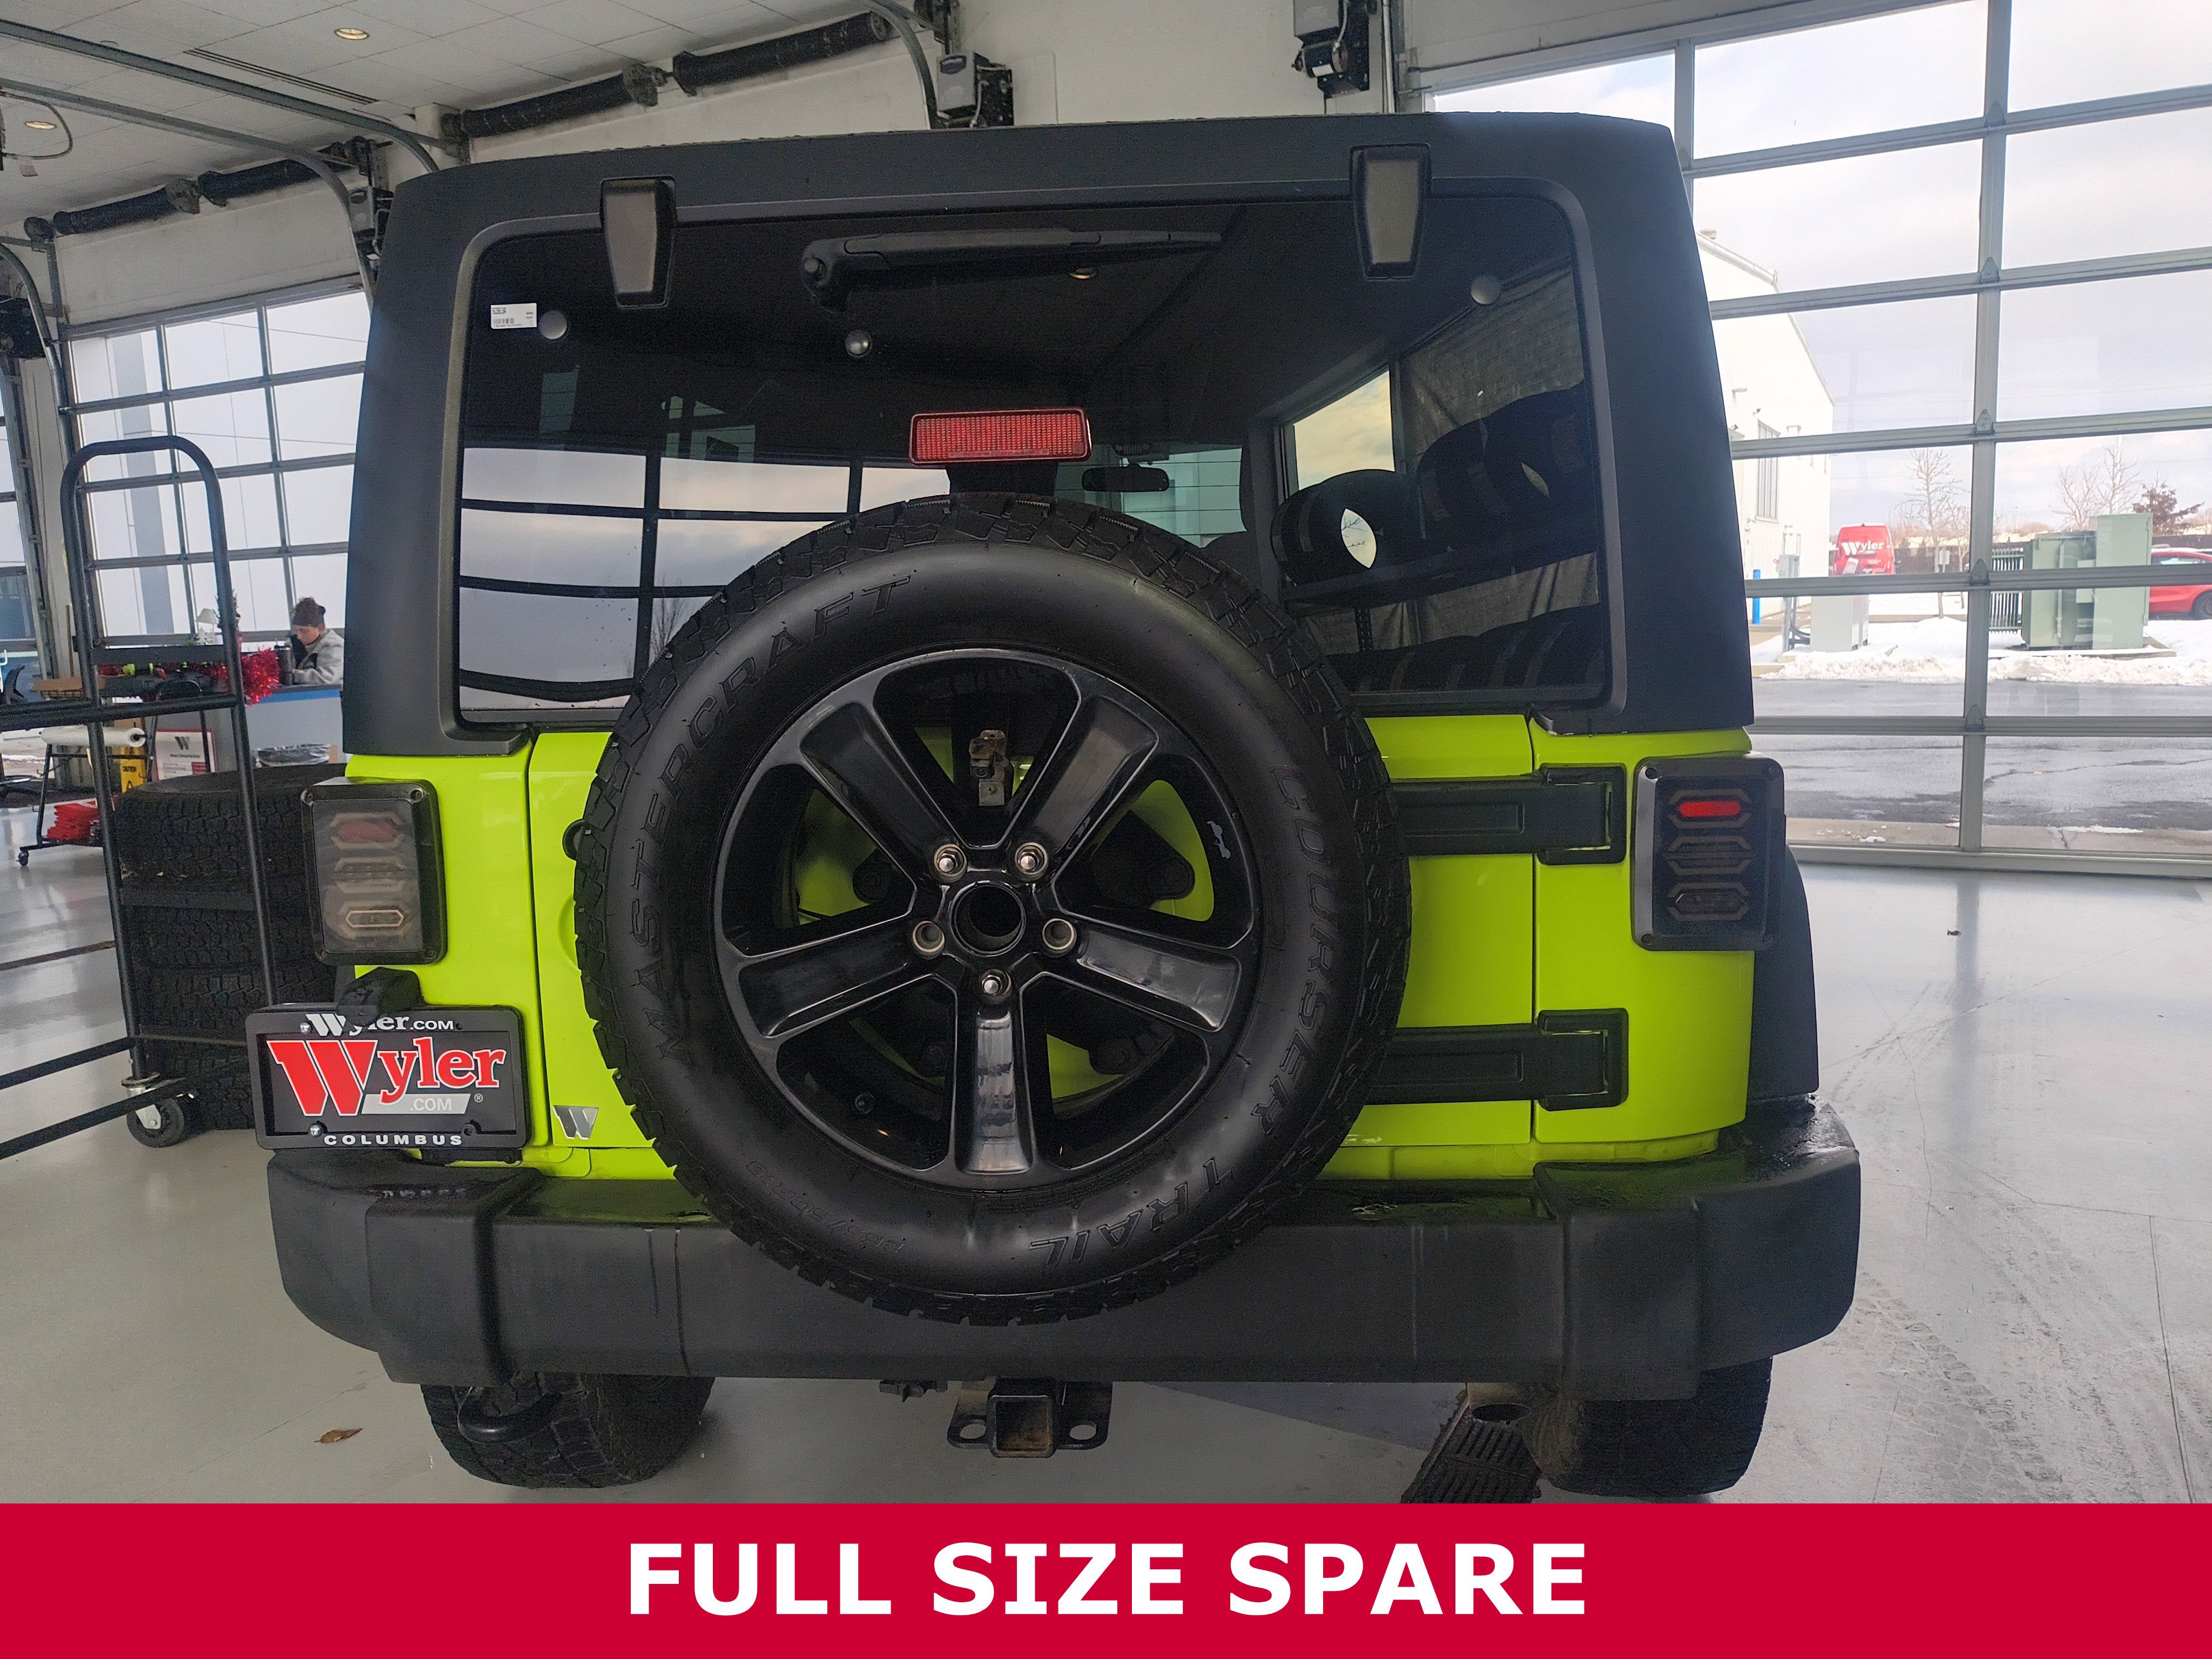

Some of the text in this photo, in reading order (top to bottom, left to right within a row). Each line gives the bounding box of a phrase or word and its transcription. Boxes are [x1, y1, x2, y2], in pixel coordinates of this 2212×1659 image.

[1841, 541, 1884, 555] Wyler
[630, 575, 913, 1067] MASTERCRAFT
[1028, 765, 1339, 1269] COURSER TRAIL
[266, 1036, 506, 1116] Wyler
[324, 1134, 462, 1145] COLUMBUS
